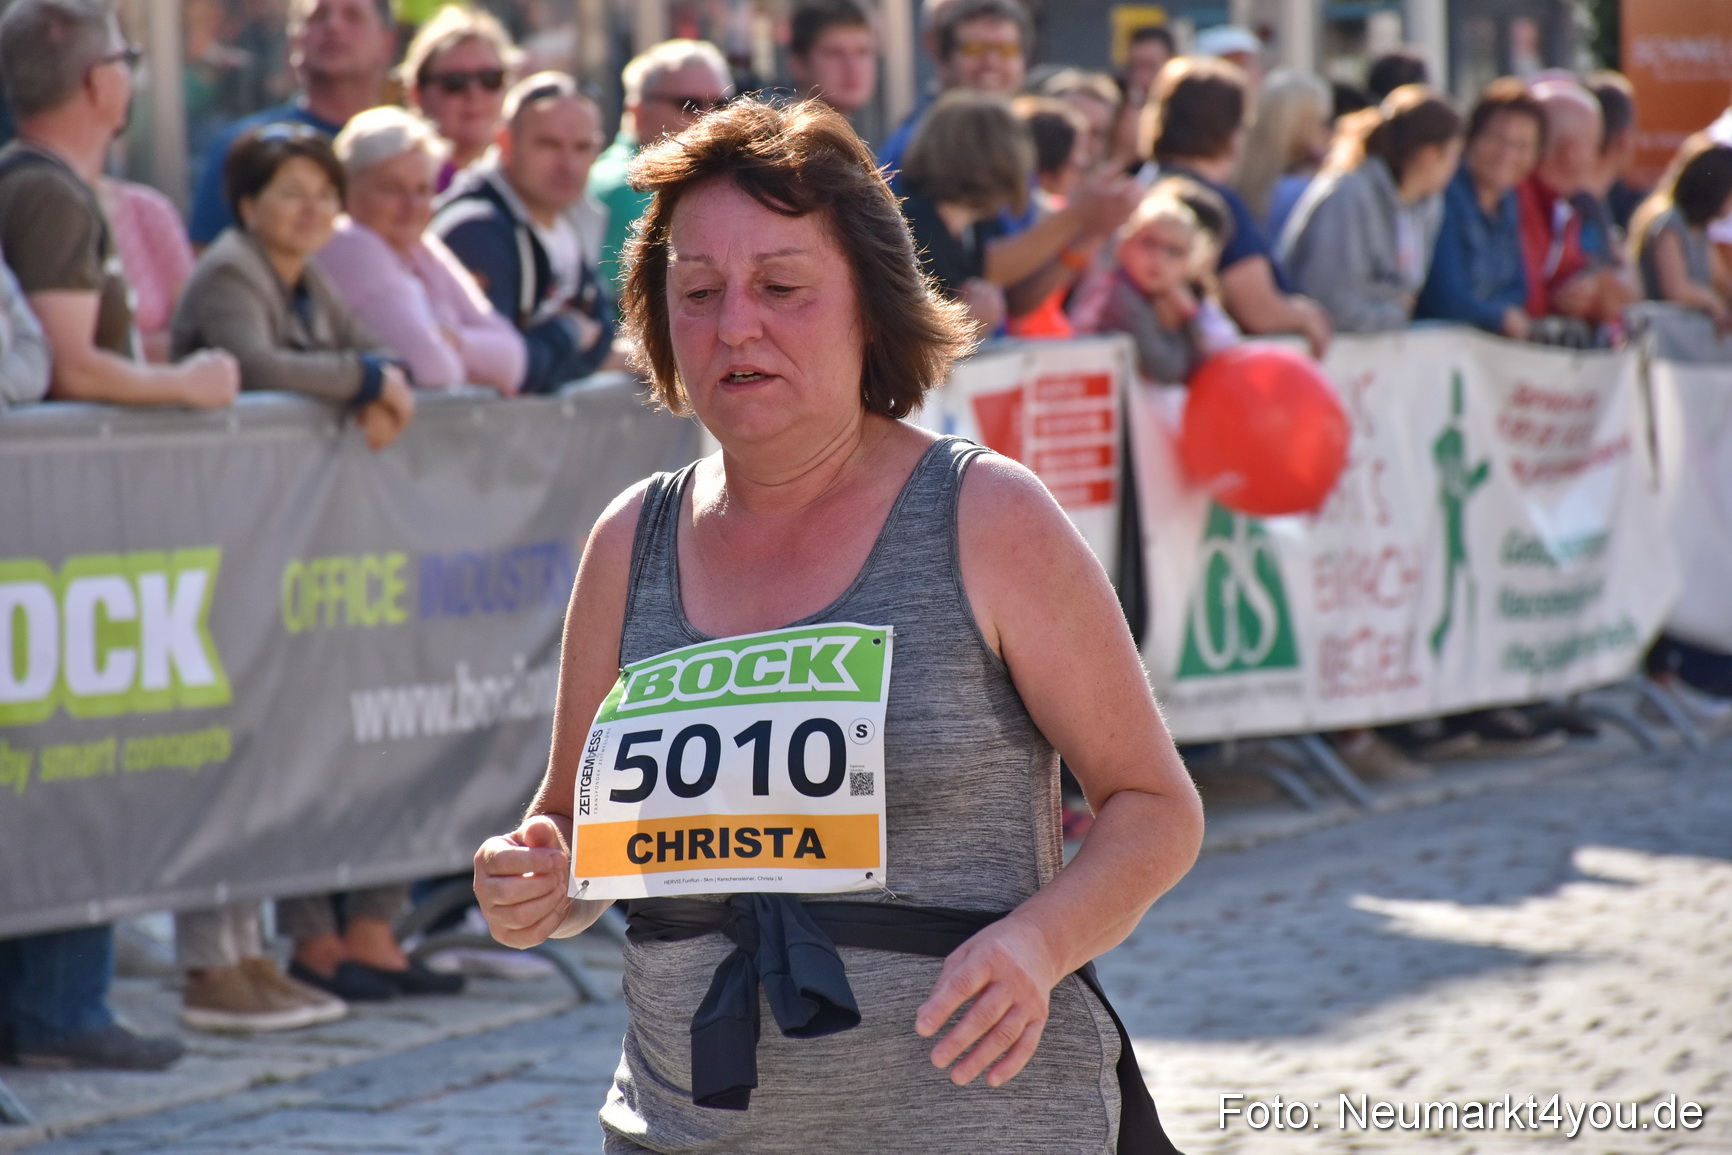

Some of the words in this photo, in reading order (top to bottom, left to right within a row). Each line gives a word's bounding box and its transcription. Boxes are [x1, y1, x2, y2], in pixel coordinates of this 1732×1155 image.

[281, 553, 408, 633] OFFICE
[622, 640, 852, 707] BOCK
[608, 717, 847, 804] 5010
[855, 723, 869, 739] S
[626, 827, 827, 865] CHRISTA
